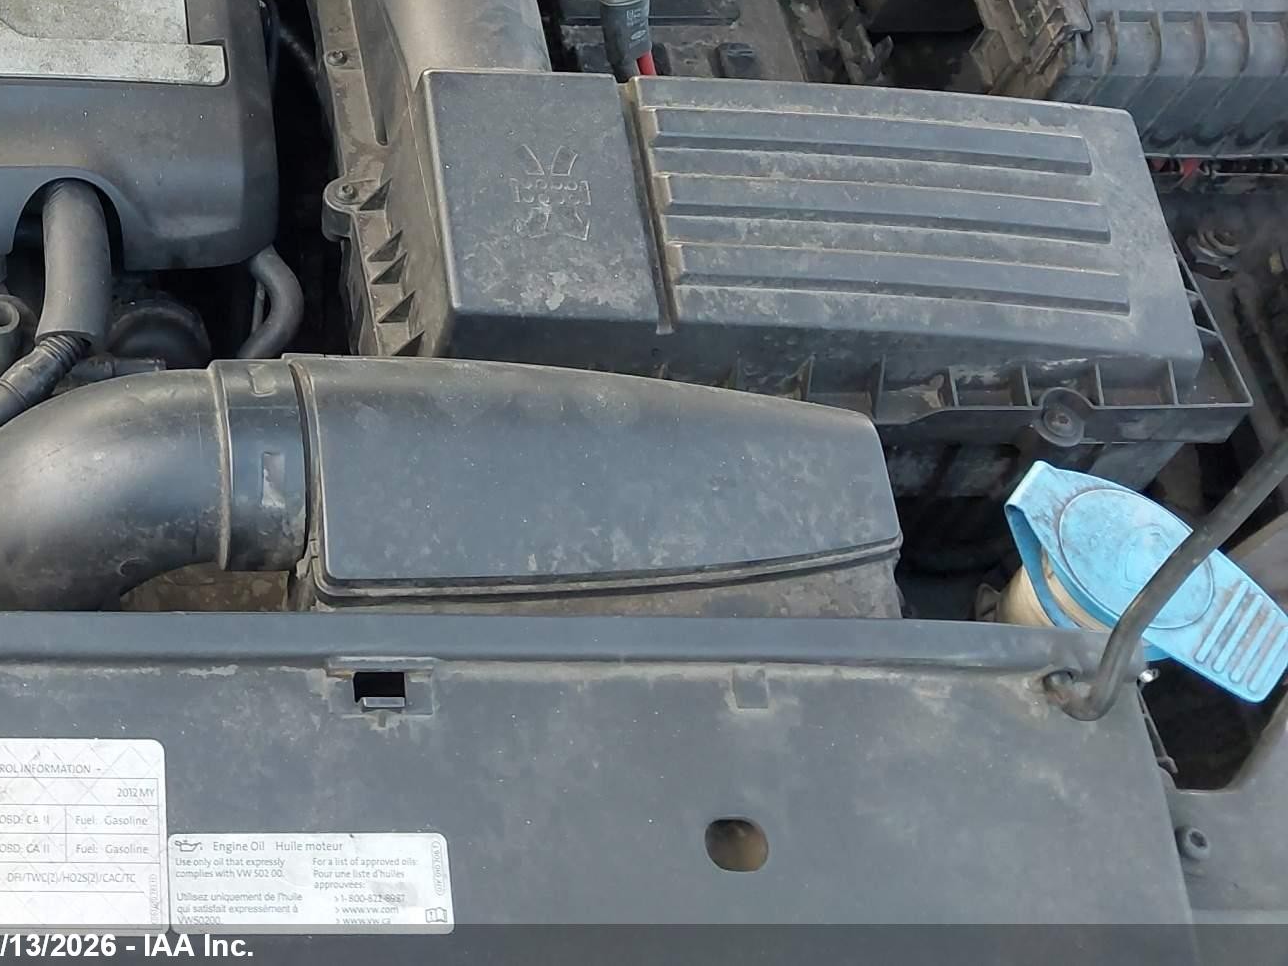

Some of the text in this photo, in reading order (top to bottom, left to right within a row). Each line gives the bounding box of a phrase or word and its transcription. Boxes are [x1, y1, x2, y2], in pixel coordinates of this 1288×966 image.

[20, 764, 91, 774] INFORMATION
[117, 788, 156, 798] 2012 MY
[104, 815, 149, 825] Gasoline
[105, 844, 149, 854] Gasoline
[213, 841, 265, 854] Engine Oil
[276, 841, 343, 851] Huile moteur
[175, 857, 286, 868] Use only oil that expressly
[312, 858, 326, 866] For
[335, 858, 348, 866] list
[350, 857, 360, 866] of
[360, 858, 400, 868] approved
[175, 869, 213, 880] complies
[215, 869, 235, 878] with
[236, 870, 252, 878] VW
[254, 869, 269, 878] 502
[314, 870, 333, 878] Pour
[353, 870, 370, 878] liste
[176, 892, 209, 901] Utilisez
[210, 893, 262, 903] uniquement
[264, 893, 275, 901] de
[177, 905, 191, 915] qui
[192, 904, 226, 913] satisfait
[342, 906, 399, 914] www.vw.com
